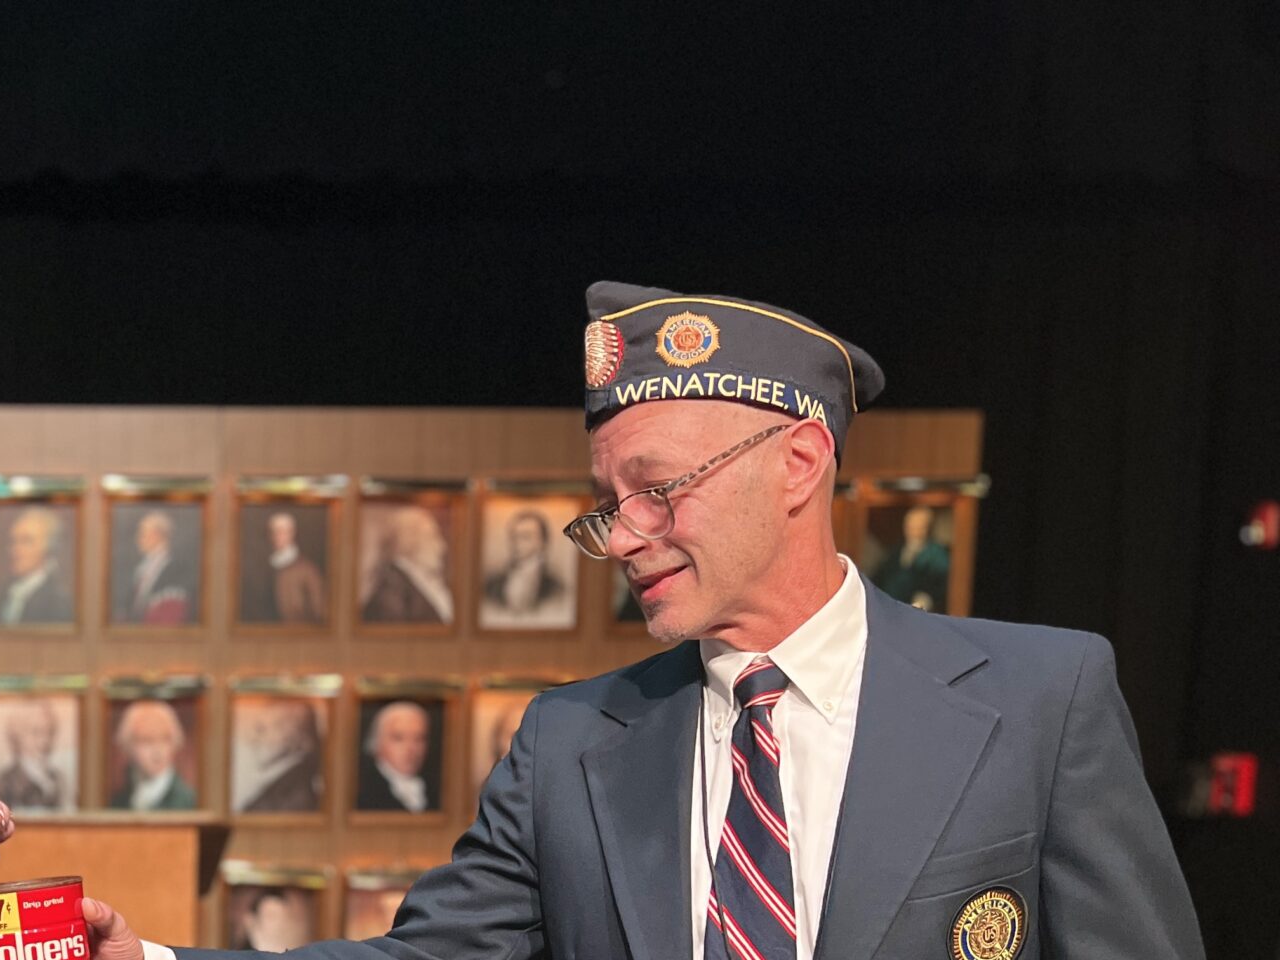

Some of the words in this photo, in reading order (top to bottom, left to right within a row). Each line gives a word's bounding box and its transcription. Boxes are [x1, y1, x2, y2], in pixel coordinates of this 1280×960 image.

[666, 320, 711, 339] AMERICAN
[669, 346, 706, 360] LEGION
[616, 372, 789, 410] WENATCHEE,
[795, 388, 828, 427] WA
[23, 900, 41, 909] Drip
[43, 896, 64, 907] grind
[964, 900, 1016, 932] AMERICAN
[984, 927, 996, 943] US
